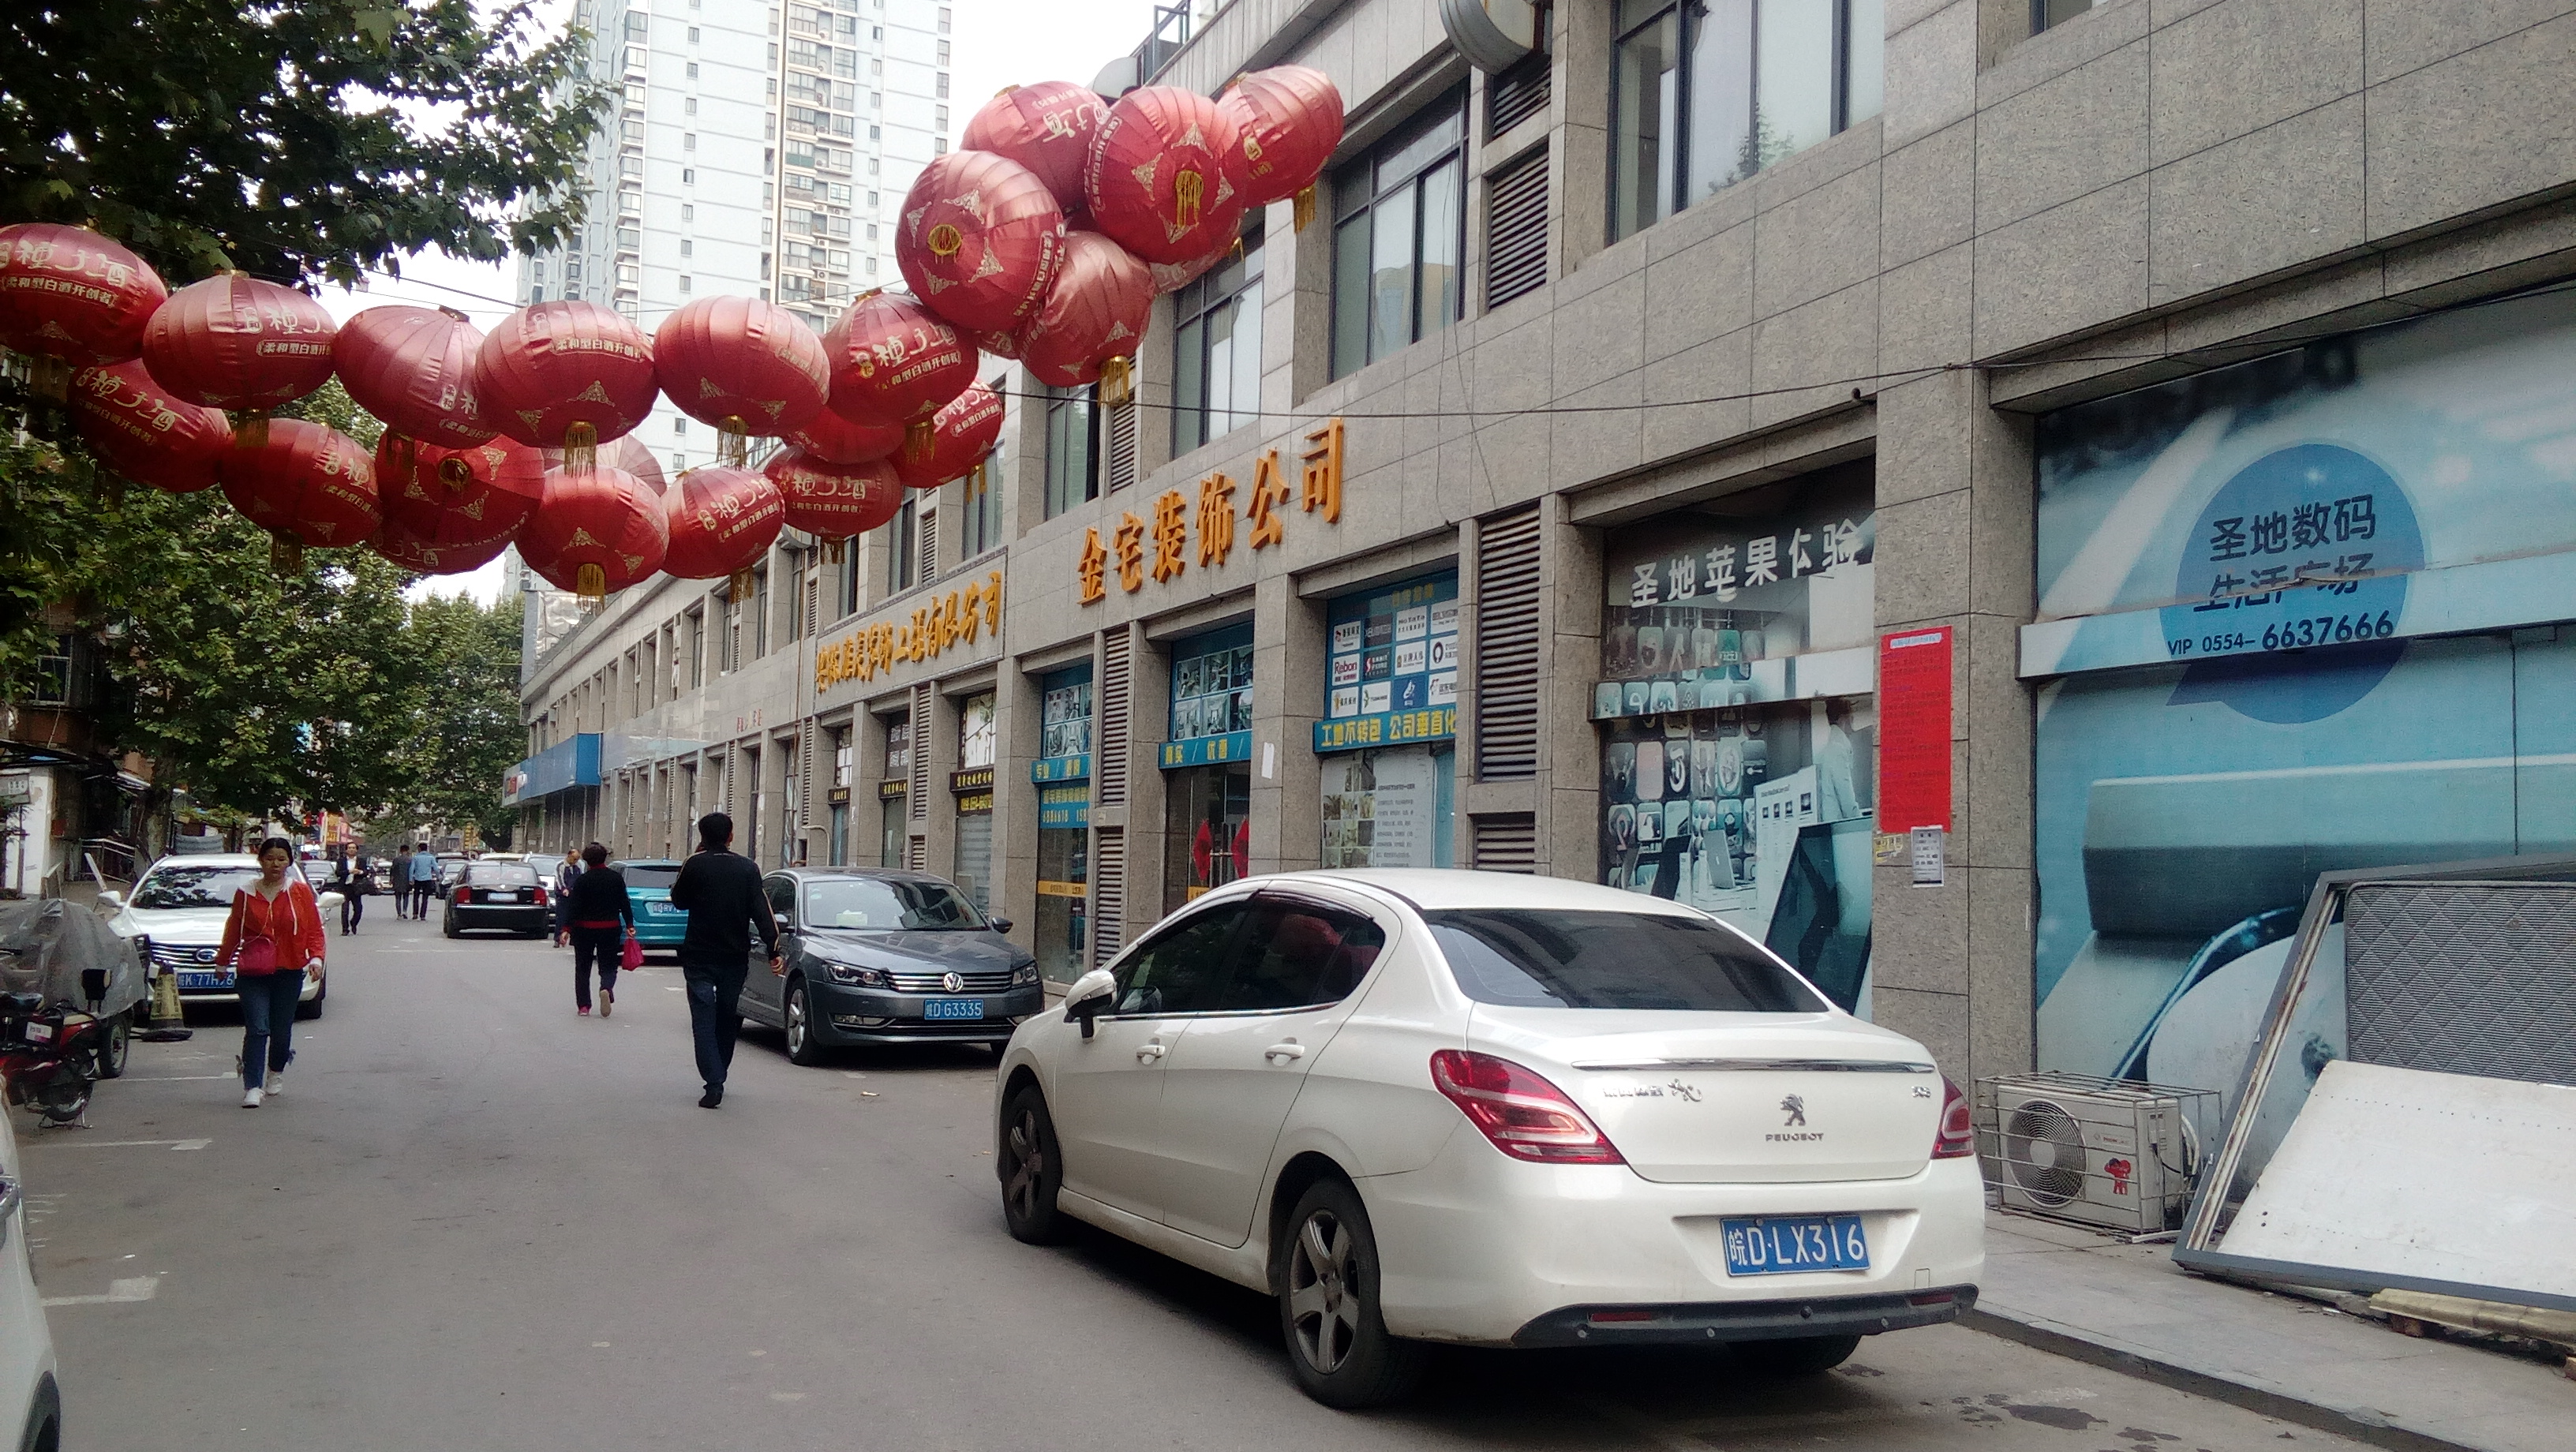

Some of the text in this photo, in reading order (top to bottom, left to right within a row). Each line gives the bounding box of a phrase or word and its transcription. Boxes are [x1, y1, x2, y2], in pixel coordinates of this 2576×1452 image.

[1077, 418, 1344, 606] 金宅装饰公司
[2210, 494, 2376, 561] 圣地数码
[2167, 638, 2193, 657] VIP
[1765, 1133, 1824, 1142] PEUGEOT
